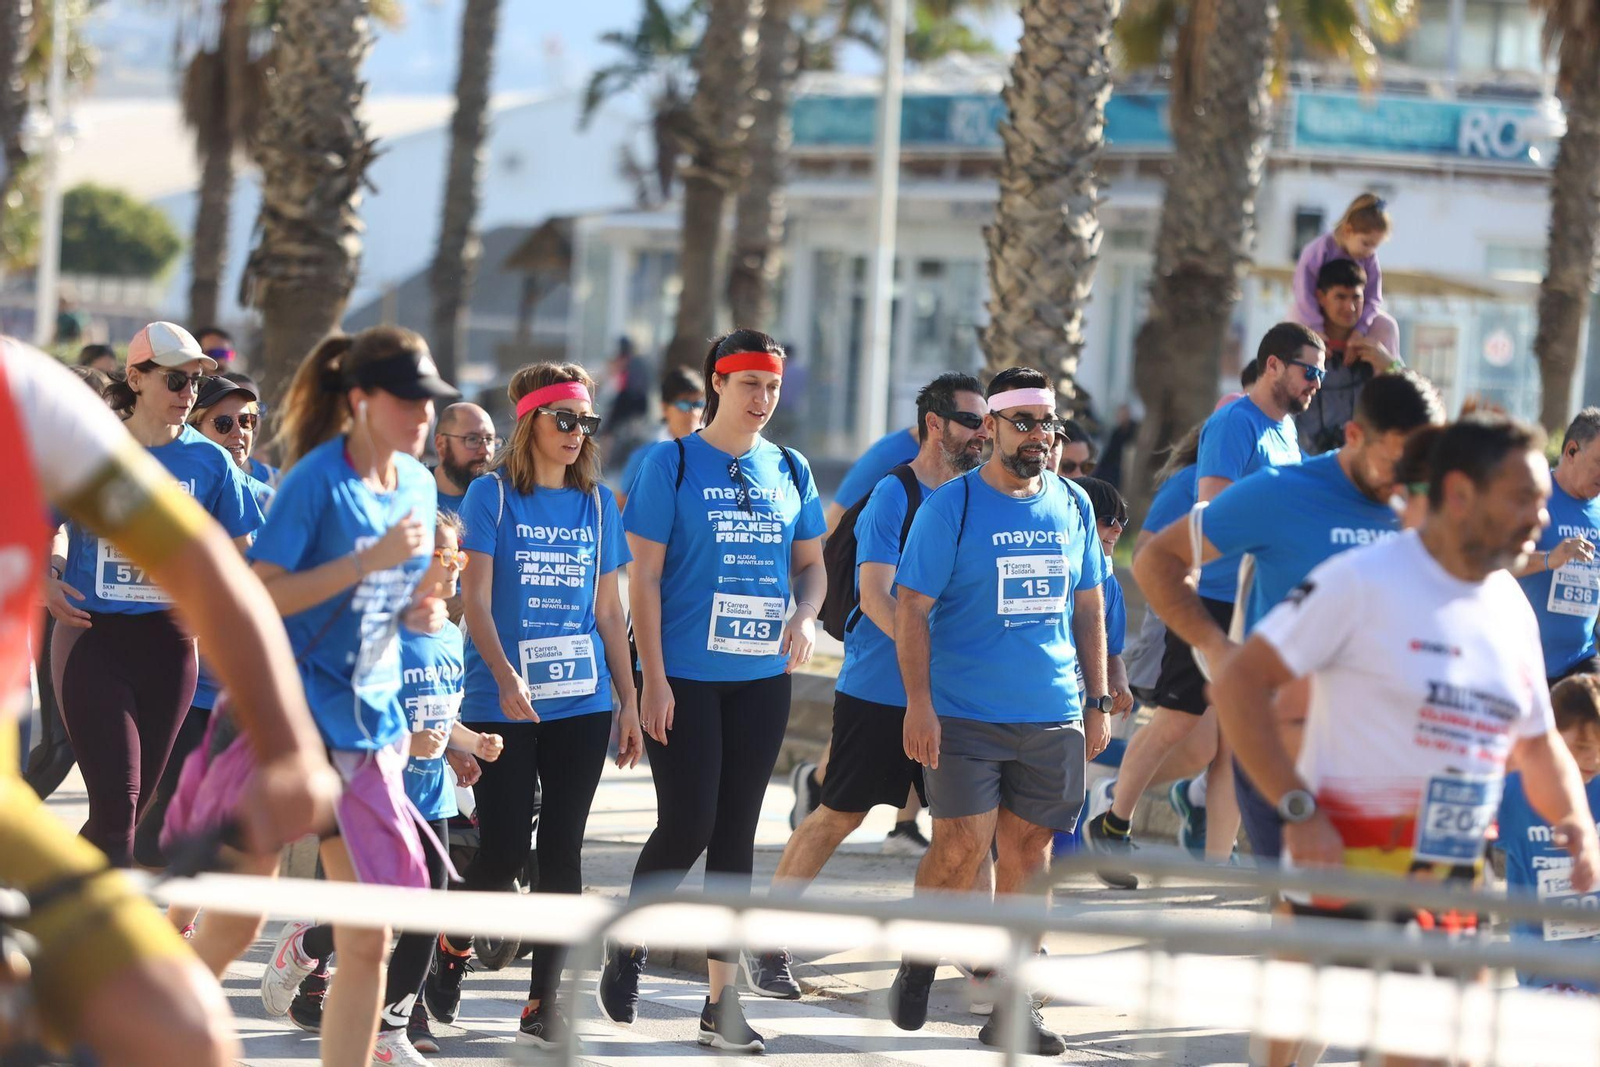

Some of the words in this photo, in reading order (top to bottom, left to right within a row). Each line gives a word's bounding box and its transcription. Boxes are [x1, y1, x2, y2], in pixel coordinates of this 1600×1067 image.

[516, 524, 594, 544] mayoral
[718, 521, 782, 532] MAKES
[716, 532, 783, 544] FRIENDS
[992, 529, 1070, 548] mayoral
[515, 551, 592, 565] RUNNING
[523, 562, 587, 577] MAKES
[521, 574, 585, 588] FRIENDS
[1021, 579, 1050, 597] 15
[1563, 586, 1593, 603] 636
[729, 620, 771, 639] 143
[535, 651, 563, 659] Solidaria
[549, 661, 576, 680] 97
